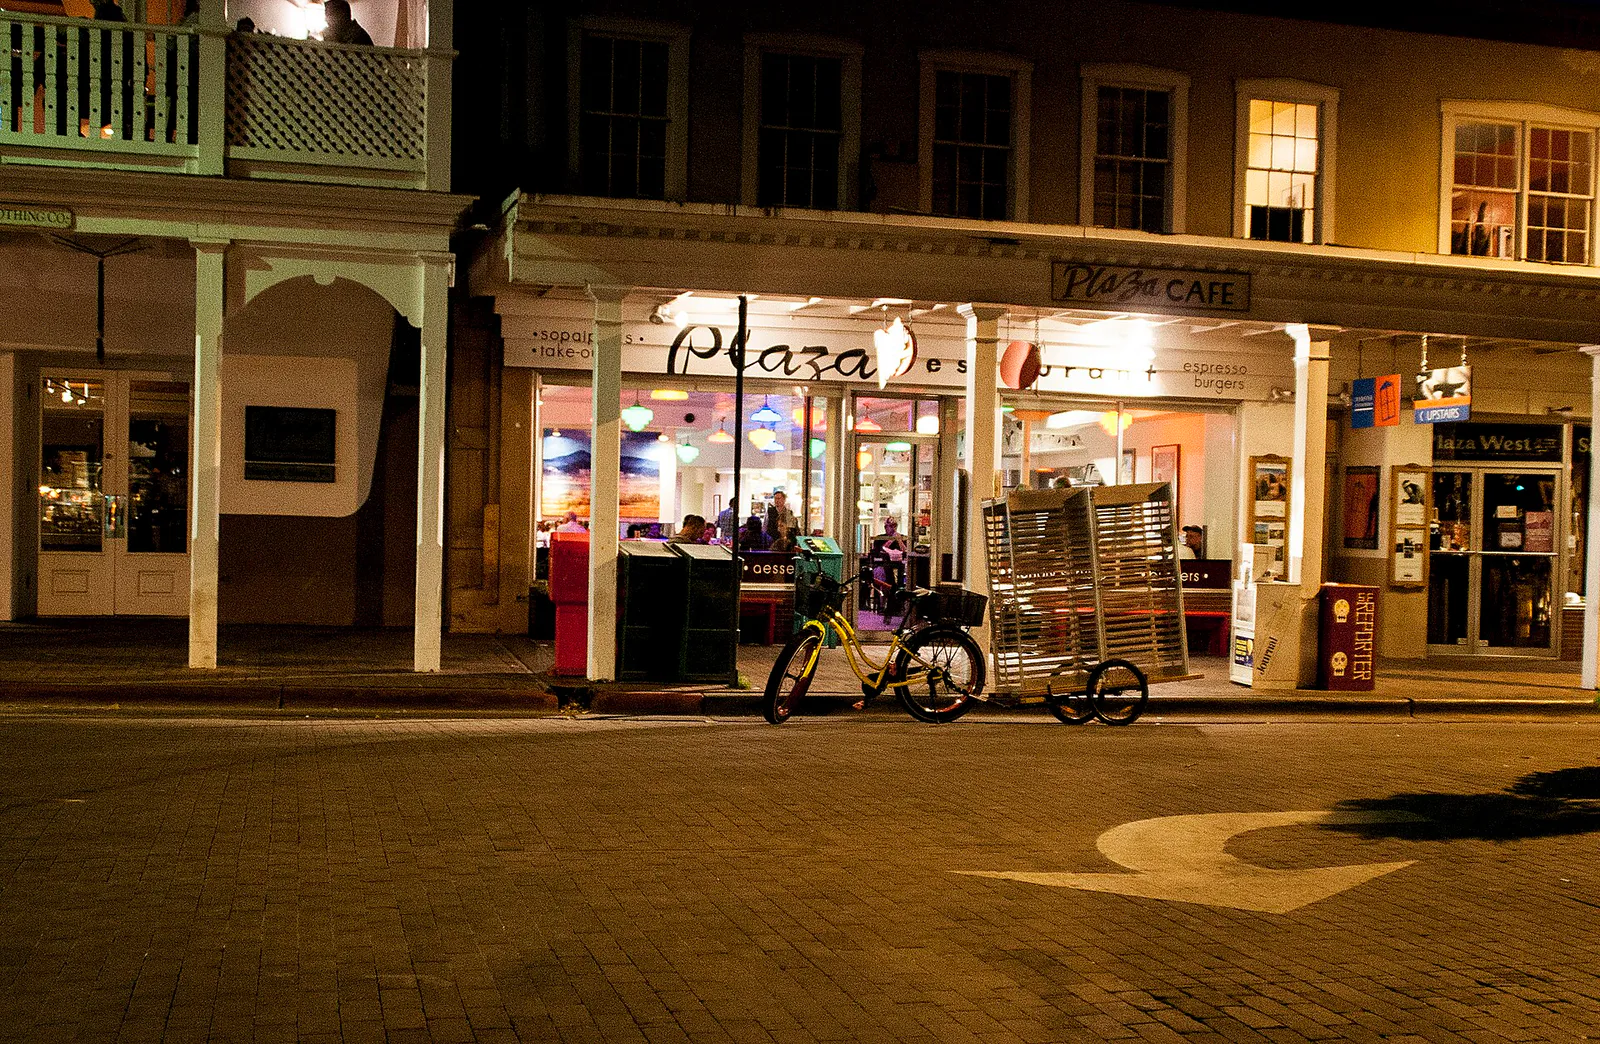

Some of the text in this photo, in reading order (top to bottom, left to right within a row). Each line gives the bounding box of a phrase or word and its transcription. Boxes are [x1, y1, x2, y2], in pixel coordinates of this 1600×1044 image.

[1063, 264, 1235, 305] Plaza CAFE
[667, 325, 877, 381] Plaza
[1183, 361, 1248, 377] espresso
[1194, 375, 1245, 395] burgers
[1426, 408, 1460, 421] UPSTAIRS
[1436, 434, 1476, 450] laza
[1480, 435, 1532, 451] West
[1256, 636, 1278, 676] Journal
